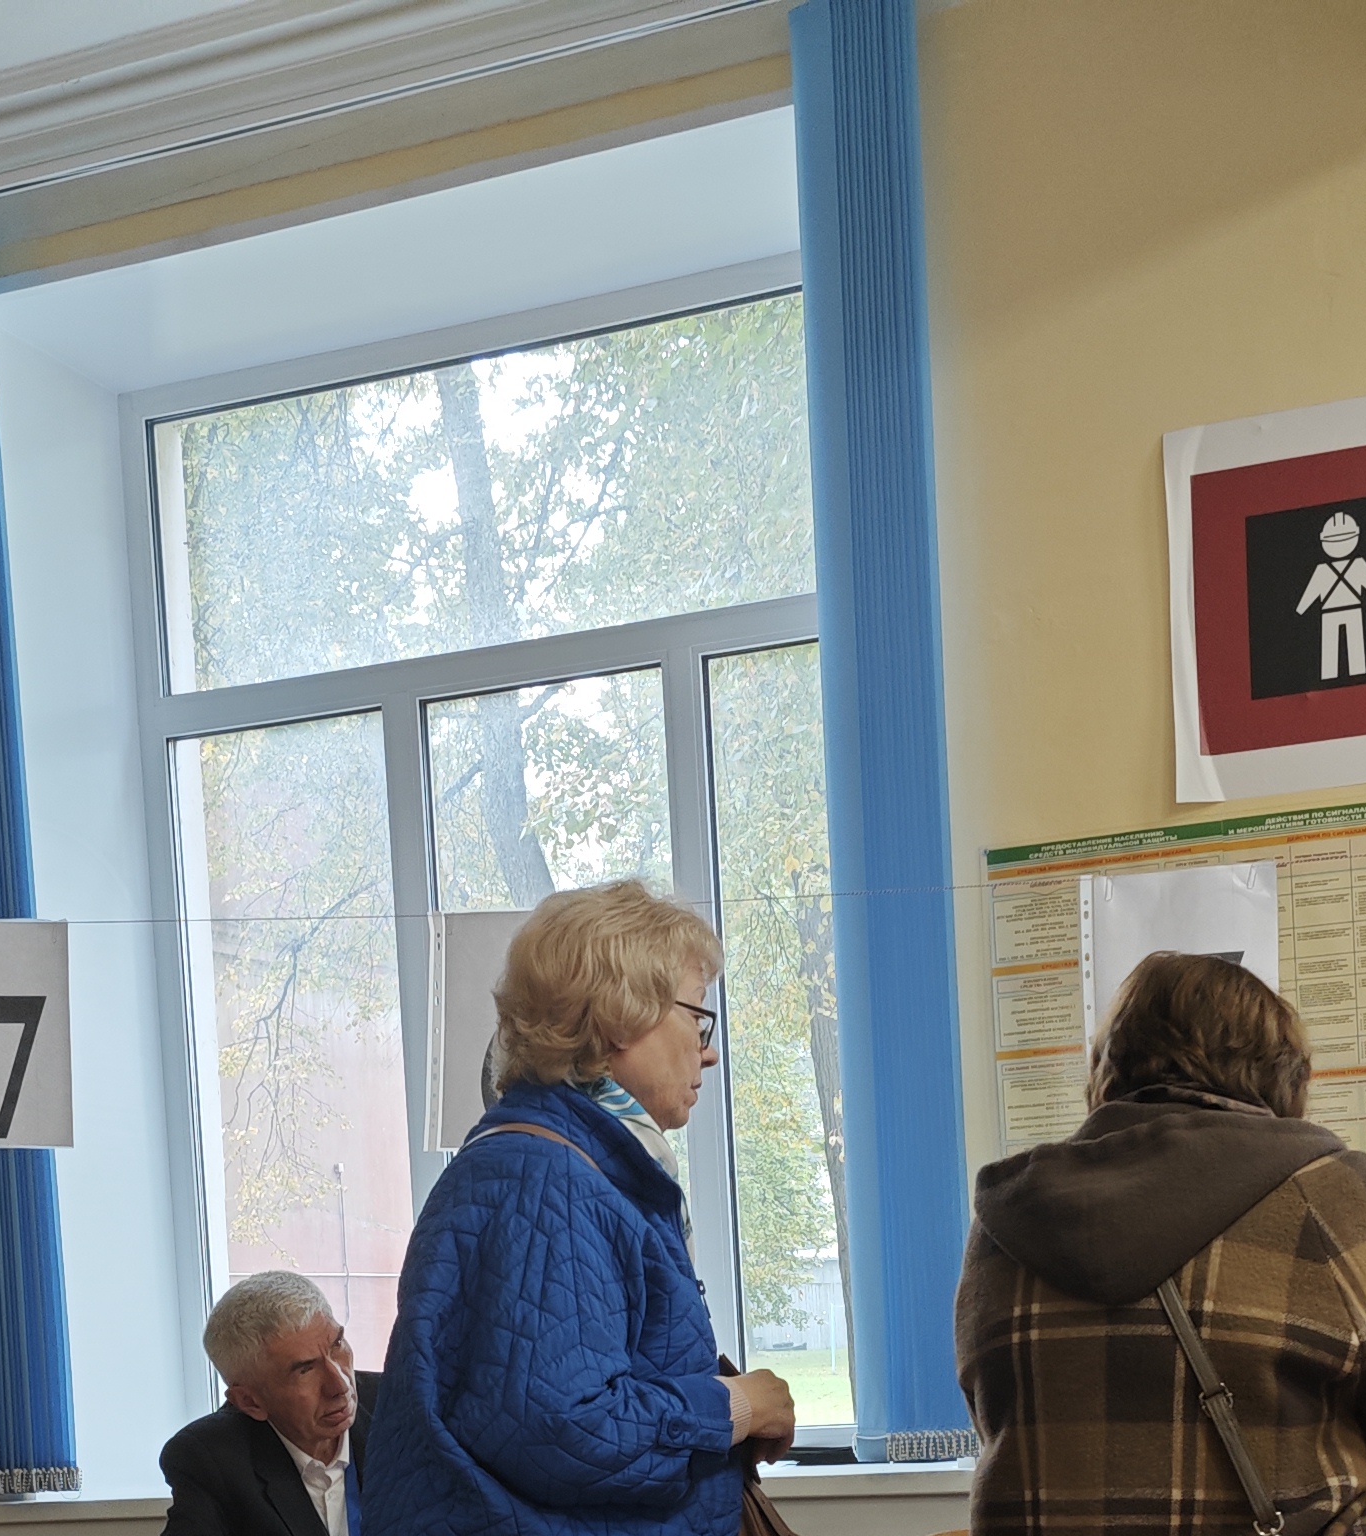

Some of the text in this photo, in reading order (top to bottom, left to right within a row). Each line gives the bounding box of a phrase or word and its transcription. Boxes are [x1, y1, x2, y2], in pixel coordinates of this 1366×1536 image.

[1236, 820, 1304, 834] МЕРОПРИЯТИЯМ
[1306, 813, 1362, 825] ГОТОВНОСТИ
[1265, 813, 1310, 824] ДЕЙСТВИЯ
[1312, 811, 1323, 819] ПО
[1029, 835, 1177, 859] СРЕДСТВ ИНДИВИДУАЛЬНОЙ ЗАЩИТЫ
[1041, 830, 1164, 852] ПРЕДОСТАВЛЕНИЕ НАСЕЛЕНИЮ
